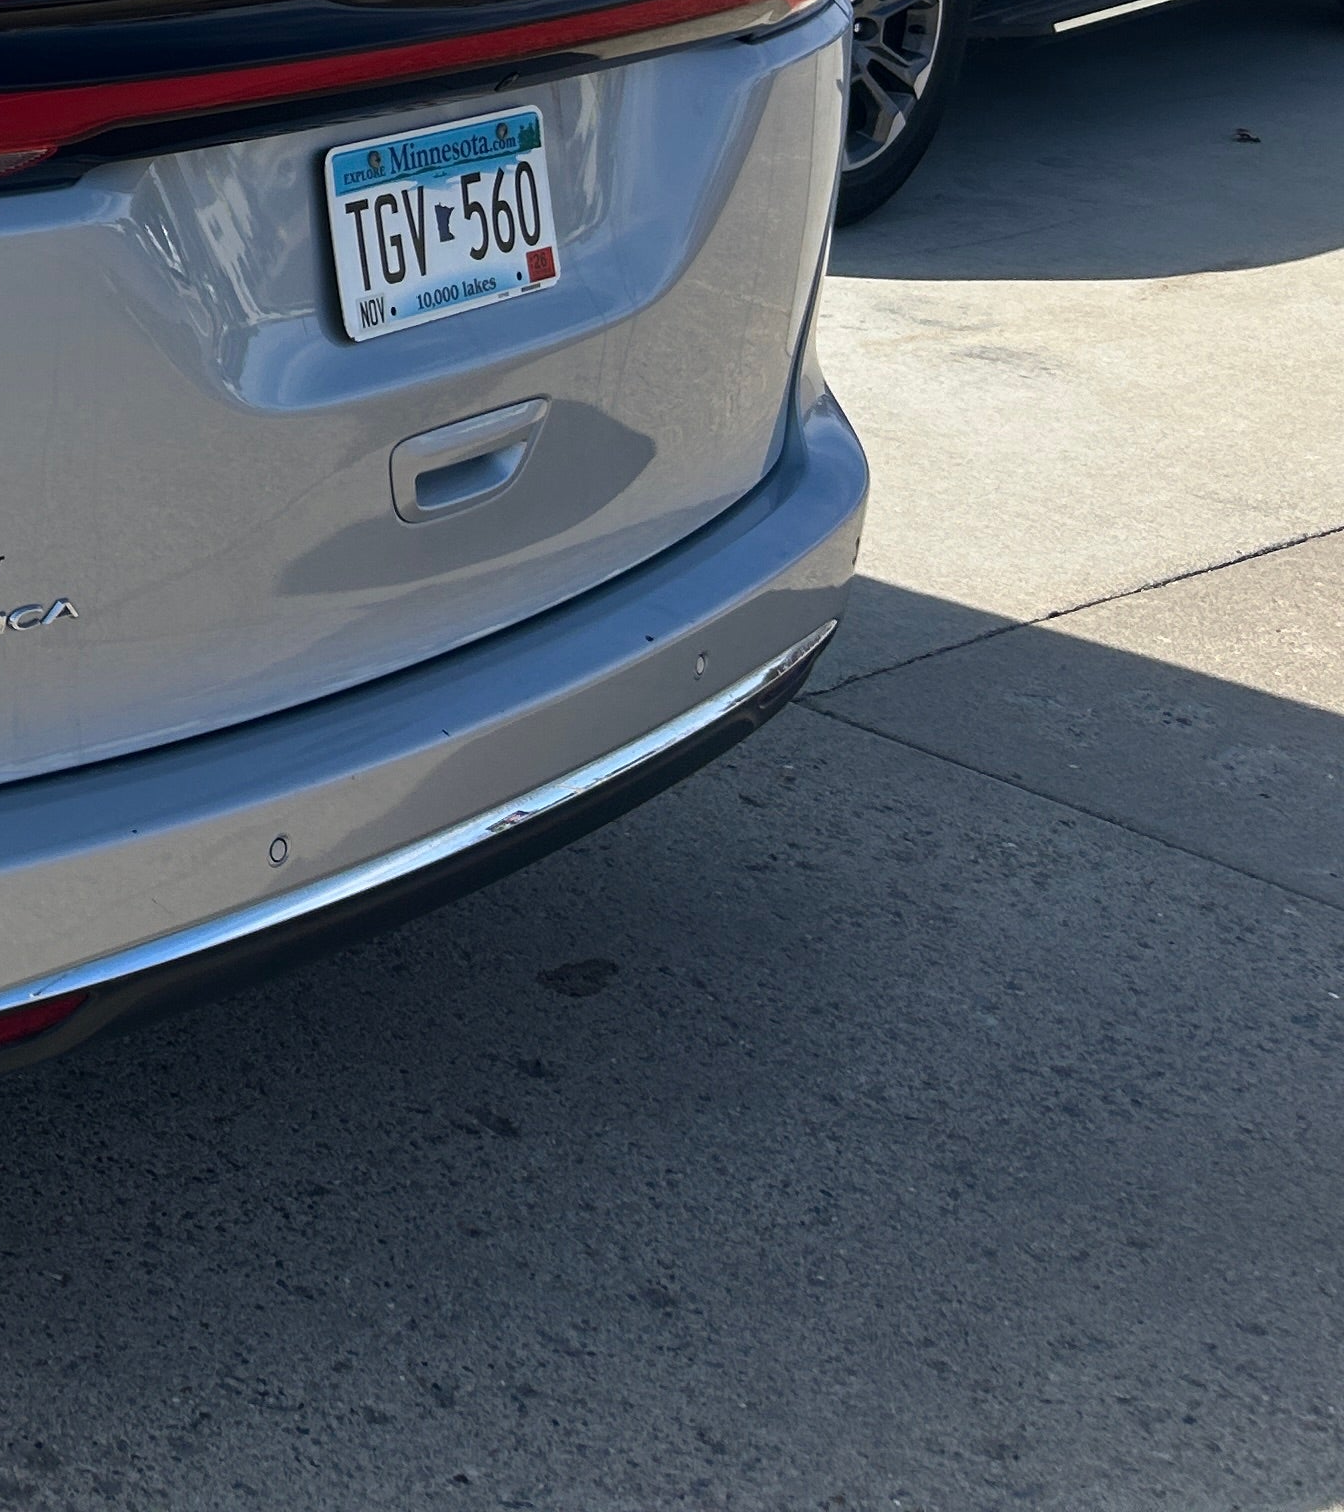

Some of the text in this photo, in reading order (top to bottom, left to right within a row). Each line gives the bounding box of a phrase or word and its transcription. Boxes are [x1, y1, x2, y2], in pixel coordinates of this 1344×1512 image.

[343, 134, 518, 186] EXPLORE Minnesota.com
[345, 161, 541, 291] TGV 560
[359, 296, 386, 328] NOV
[416, 276, 497, 310] 10,000 lakes
